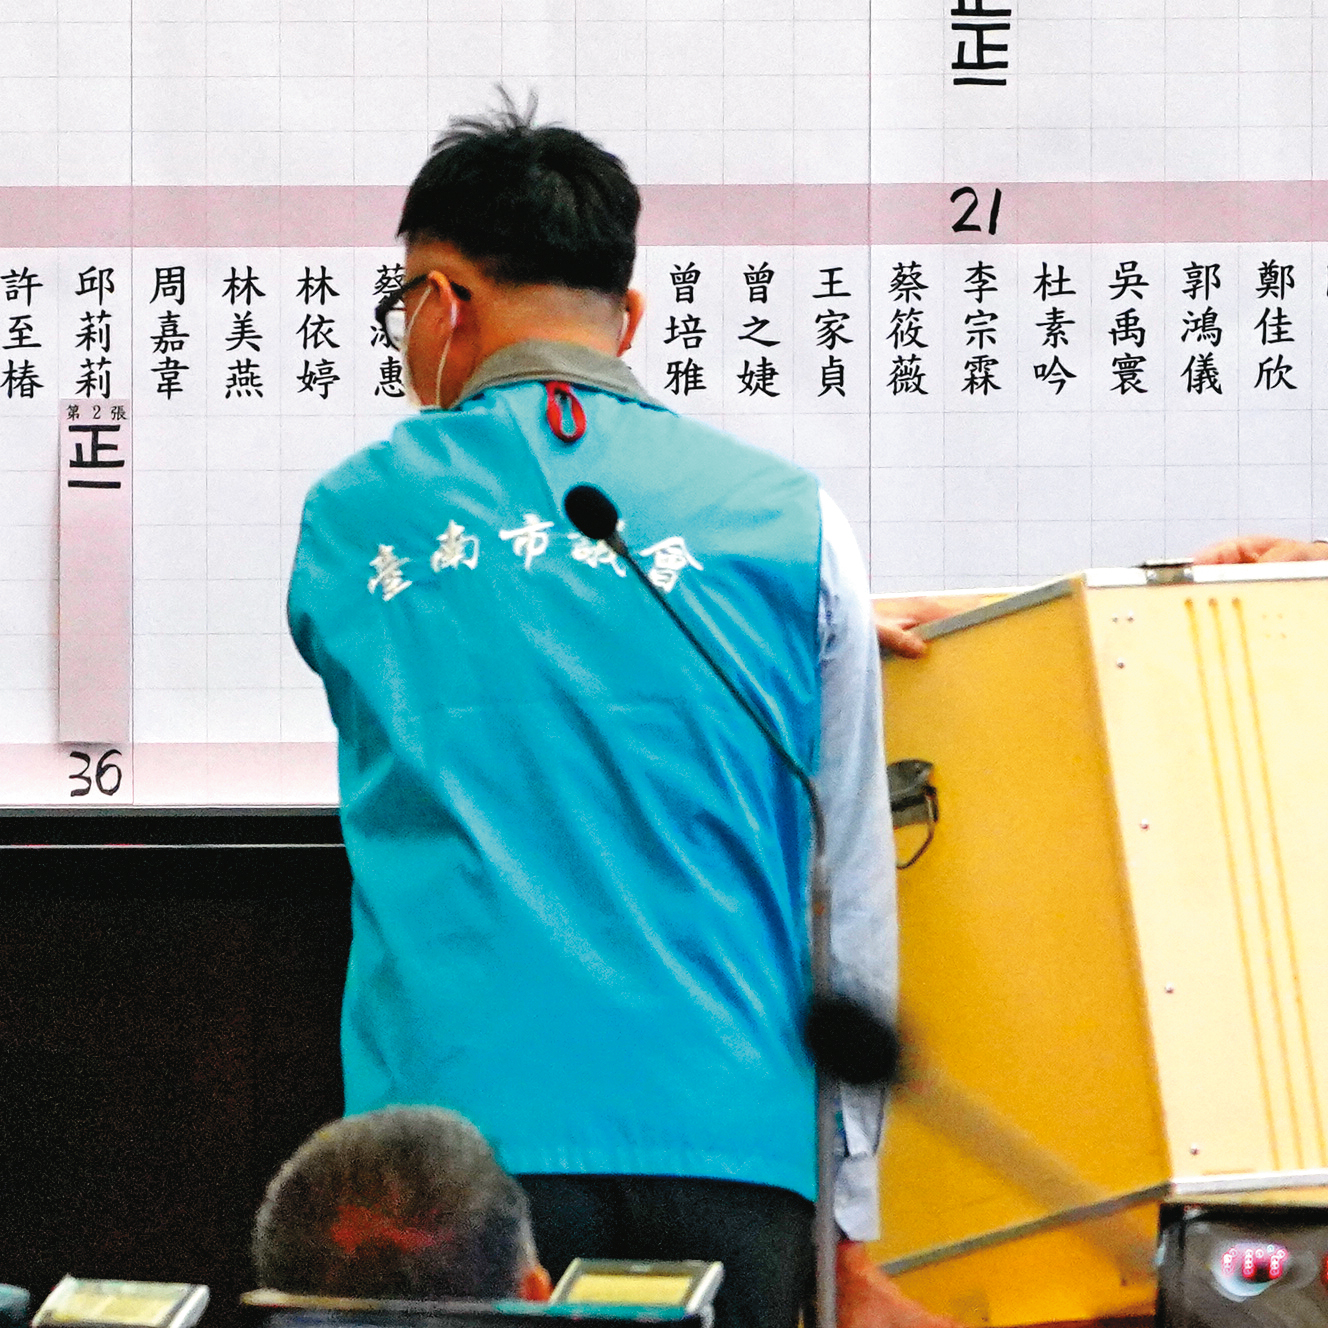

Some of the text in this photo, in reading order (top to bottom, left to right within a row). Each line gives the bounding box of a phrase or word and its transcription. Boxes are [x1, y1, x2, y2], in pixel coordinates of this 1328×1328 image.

[950, 187, 1001, 235] 21
[1, 267, 43, 398] 許至椿
[76, 266, 114, 398] 邱莉莉
[151, 266, 189, 399] 周嘉韋
[224, 266, 265, 398] 林美燕
[297, 266, 340, 399] 林依婷
[665, 262, 706, 395] 曾培雅
[738, 262, 779, 397] 曾之婕
[813, 267, 852, 396] 王家貞
[962, 261, 1000, 395] 李宗霖
[1034, 263, 1076, 394] 杜素吟
[1109, 261, 1148, 394] 吳禹寰
[1181, 262, 1222, 394] 郭鴻儀
[1255, 260, 1296, 389] 鄭佳欣
[69, 743, 121, 796] 36
